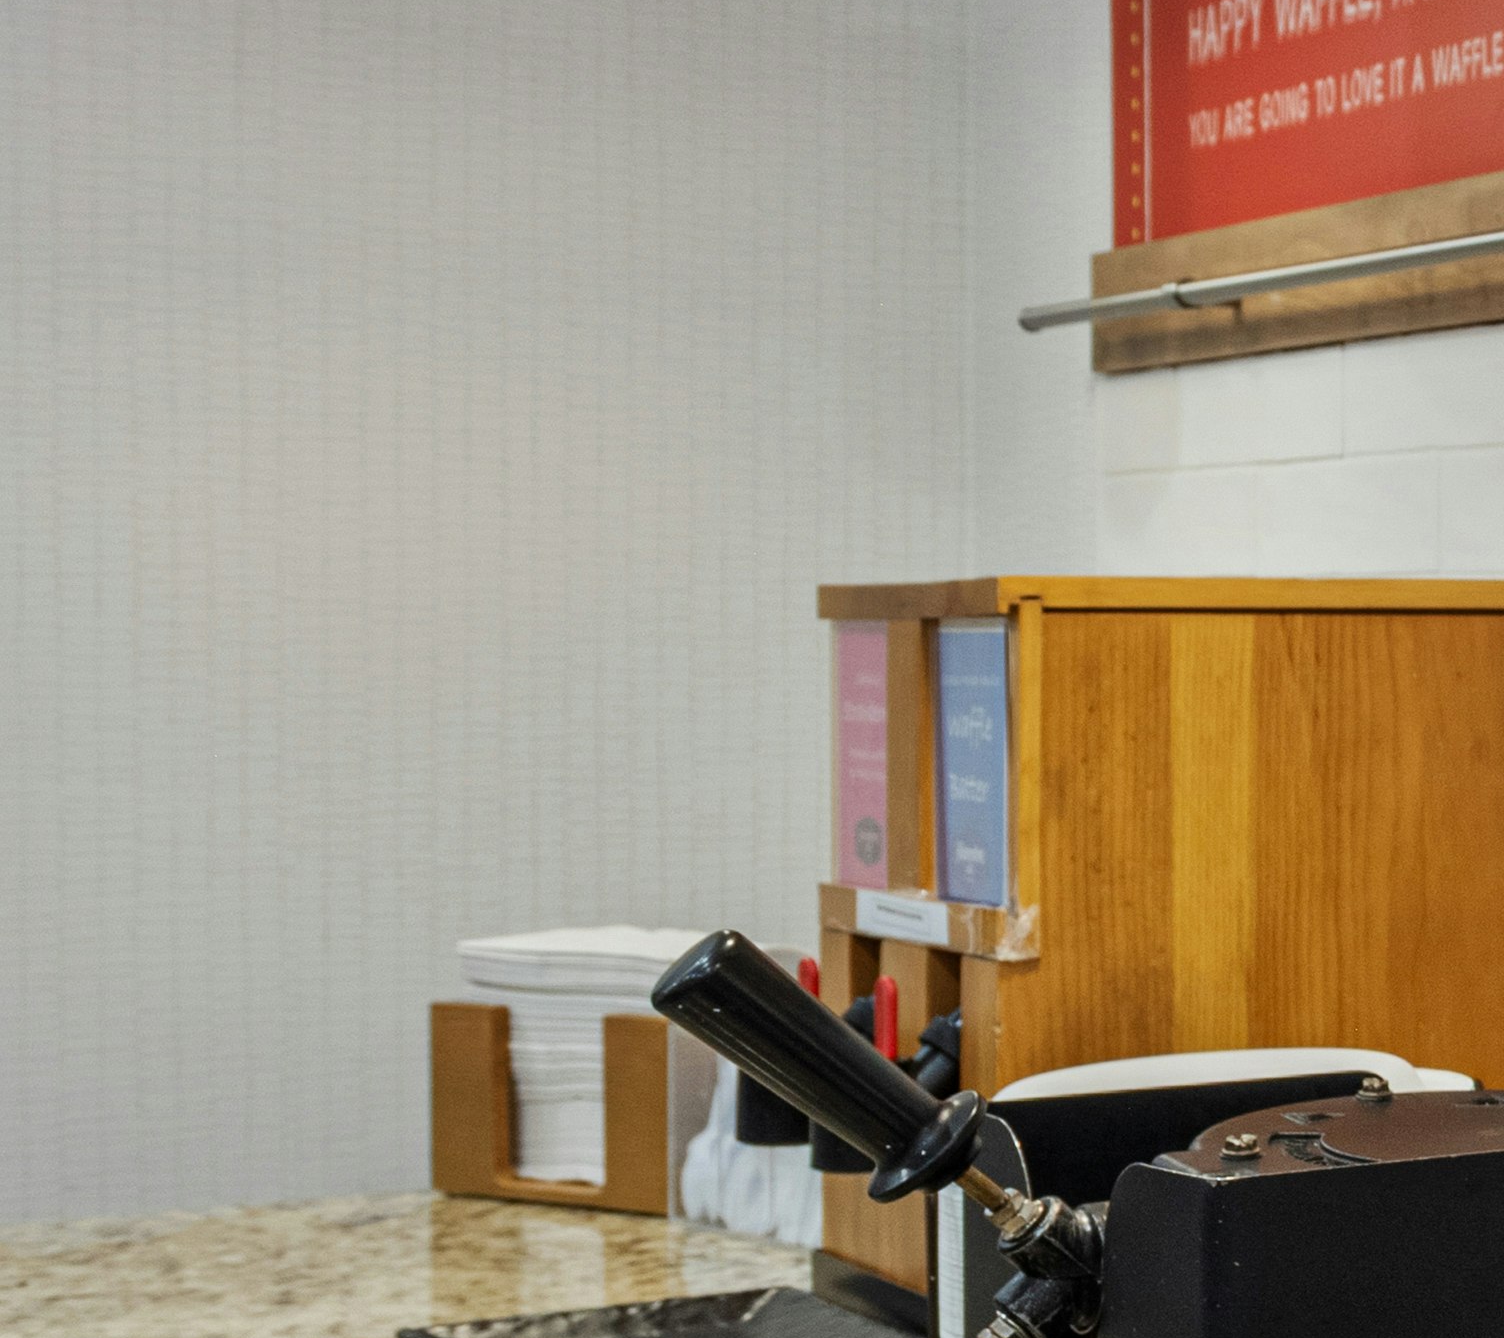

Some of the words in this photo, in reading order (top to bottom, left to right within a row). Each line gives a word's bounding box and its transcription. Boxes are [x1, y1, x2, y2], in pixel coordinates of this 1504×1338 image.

[1187, 109, 1219, 148] YOU
[1223, 98, 1256, 138] ARE
[1259, 84, 1310, 129] GOING
[1315, 74, 1337, 115] TO
[1341, 63, 1385, 111] LOVE
[1389, 56, 1406, 97] IT
[1411, 54, 1425, 93] A
